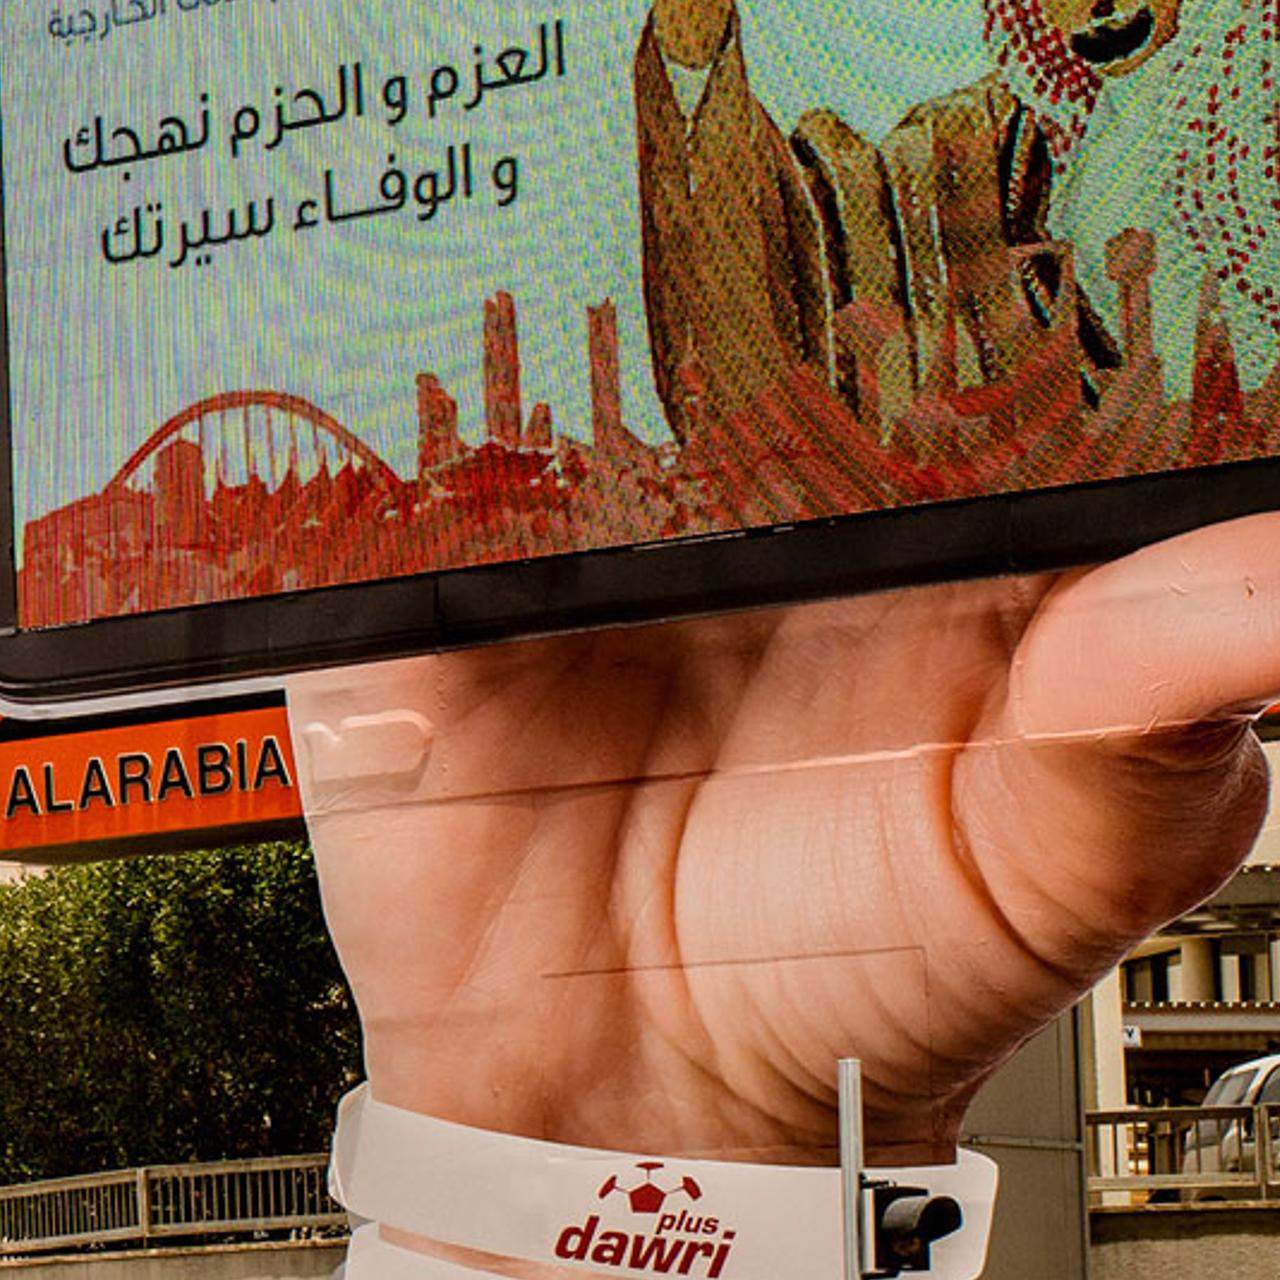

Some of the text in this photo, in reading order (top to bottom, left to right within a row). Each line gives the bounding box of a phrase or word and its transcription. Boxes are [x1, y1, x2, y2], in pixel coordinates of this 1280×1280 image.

[63, 20, 567, 181] العزم و الحزم نهجك
[100, 142, 520, 268] و الوفاء سيرتك
[4, 735, 294, 819] ALARABIA
[554, 1214, 737, 1280] dawri
[655, 1209, 720, 1235] plus
